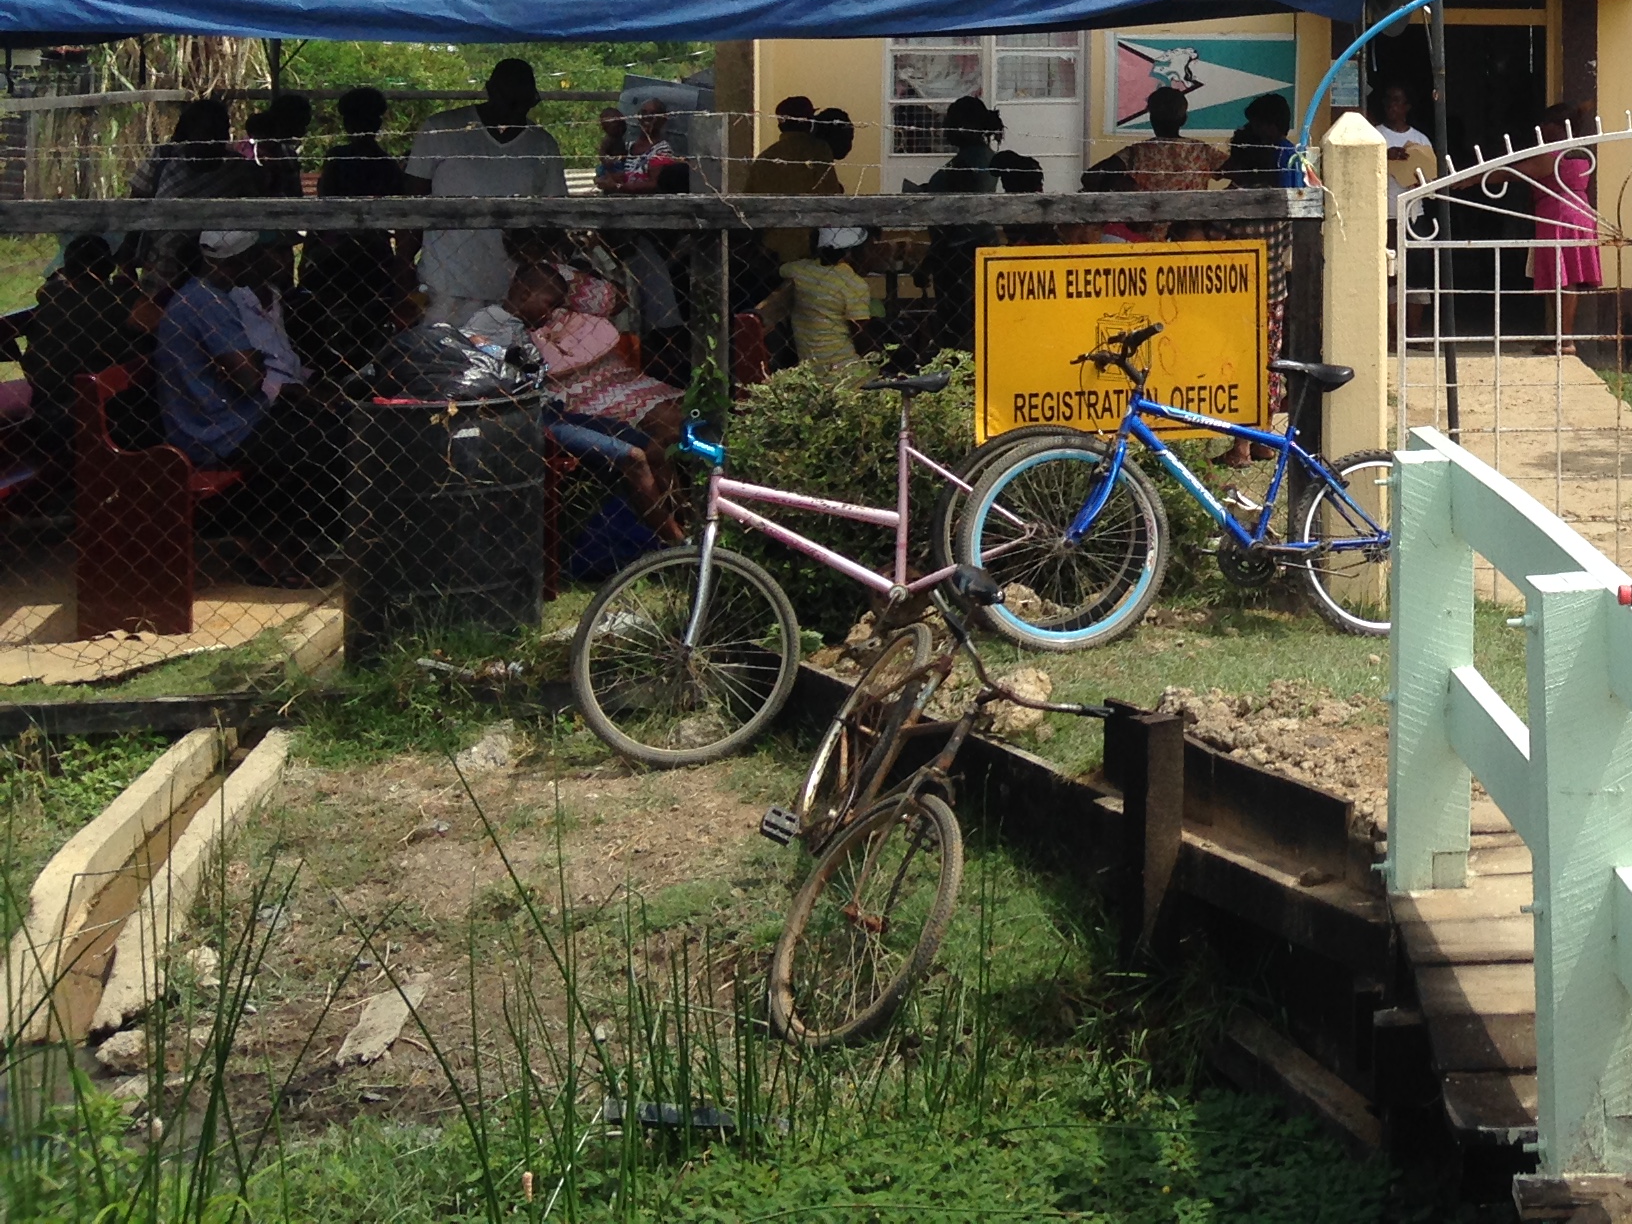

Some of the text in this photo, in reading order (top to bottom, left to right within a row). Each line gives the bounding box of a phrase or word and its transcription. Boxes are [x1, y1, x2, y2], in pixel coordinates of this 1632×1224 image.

[996, 263, 1249, 301] GUYANA ELECTIONS COMMISSION
[1013, 386, 1158, 423] REGISTRATIN
[1170, 383, 1239, 415] OFFICE
